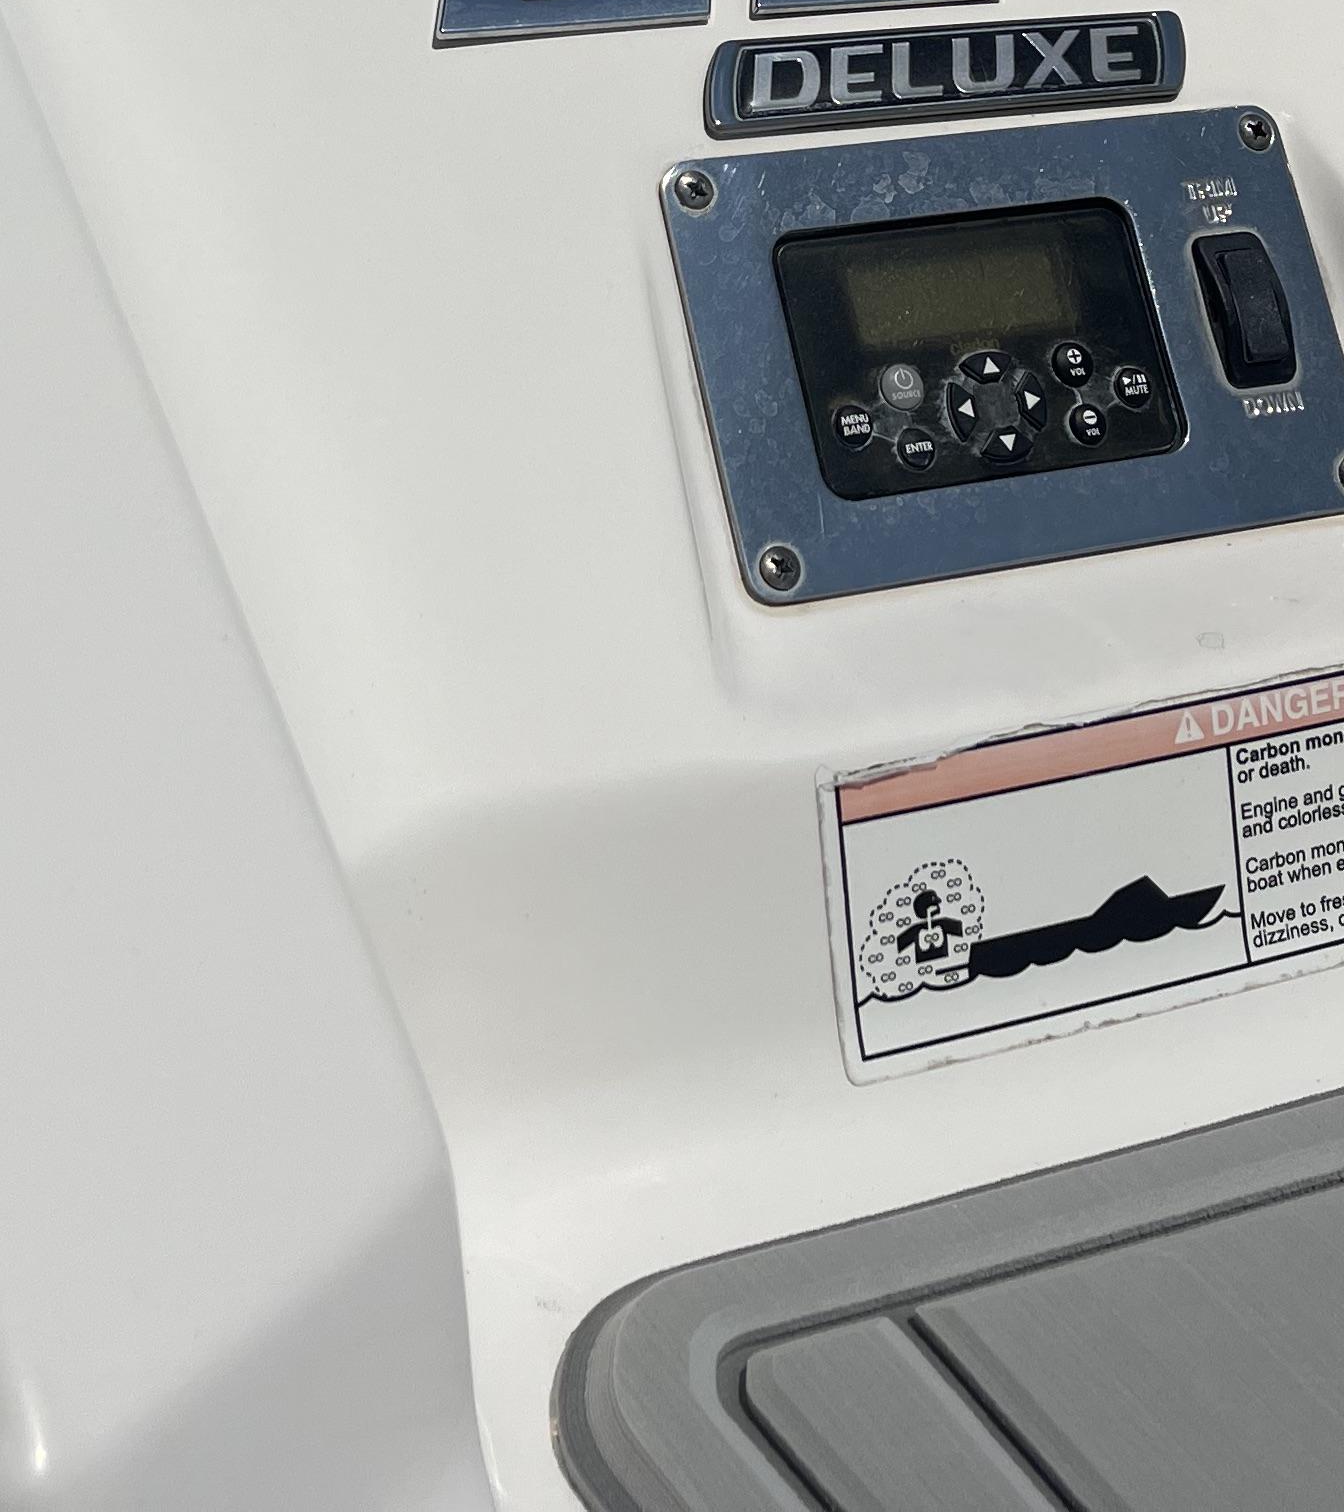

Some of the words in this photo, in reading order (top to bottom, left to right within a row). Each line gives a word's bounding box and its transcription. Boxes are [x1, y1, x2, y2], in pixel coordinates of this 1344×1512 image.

[753, 25, 1143, 111] DELUXE
[1069, 367, 1086, 377] VOL
[892, 389, 921, 401] SOURCE
[1124, 384, 1149, 397] MUTE
[1242, 391, 1305, 419] DOWN
[840, 413, 869, 426] MENU
[843, 423, 871, 436] BAND
[1085, 426, 1101, 437] VOL
[905, 441, 934, 455] ENTER
[1235, 740, 1301, 765] Carbon
[1237, 768, 1255, 784] or
[1258, 754, 1310, 779] death.
[1240, 796, 1301, 821] Engine
[1303, 783, 1334, 806] and
[1242, 815, 1274, 839] and
[1245, 849, 1306, 875] Carbon
[930, 869, 946, 880] CO
[1246, 870, 1284, 893] boat
[1286, 861, 1332, 884] when
[911, 881, 927, 893] CO
[947, 877, 962, 888] CO
[896, 896, 912, 907] CO
[946, 892, 962, 903] CO
[960, 904, 976, 915] CO
[878, 911, 894, 923] CO
[896, 916, 912, 928] CO
[1250, 907, 1296, 930] Move
[1300, 902, 1317, 918] to
[965, 925, 980, 936] CO
[1253, 918, 1334, 948] dizziness,
[879, 934, 896, 946] CO
[924, 932, 940, 944] CO
[953, 942, 969, 953] CO
[868, 952, 884, 964] CO
[895, 955, 911, 966] CO
[917, 964, 933, 976] CO
[880, 971, 896, 983] CO
[898, 981, 914, 992] CO
